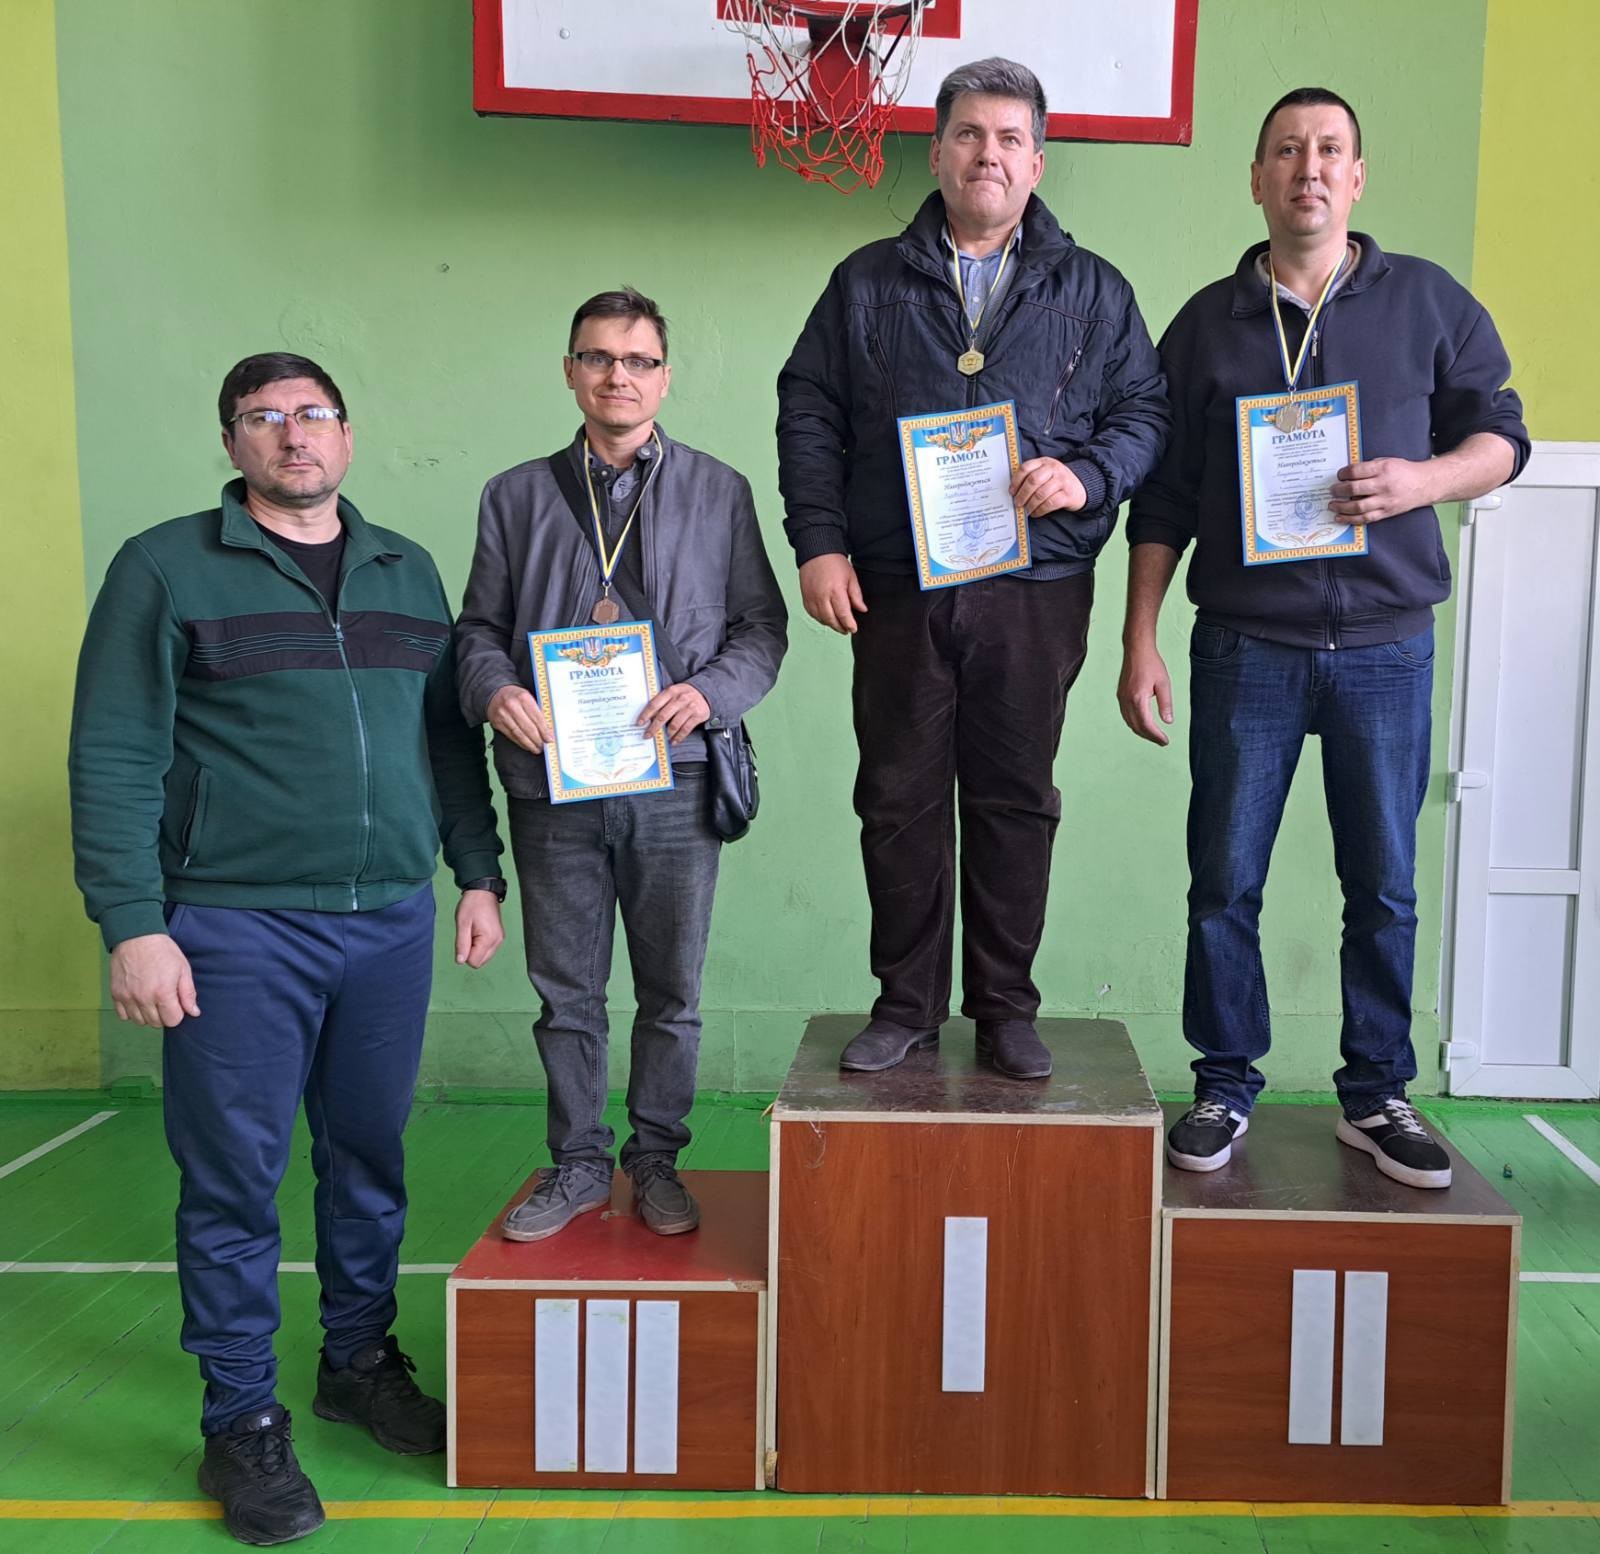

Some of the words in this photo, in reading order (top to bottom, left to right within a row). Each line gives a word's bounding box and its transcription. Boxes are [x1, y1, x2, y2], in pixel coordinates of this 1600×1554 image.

[1271, 428, 1326, 445] ГРАМОТА
[936, 449, 988, 466] ГРАМОТА
[568, 666, 625, 681] ГРАМОТА
